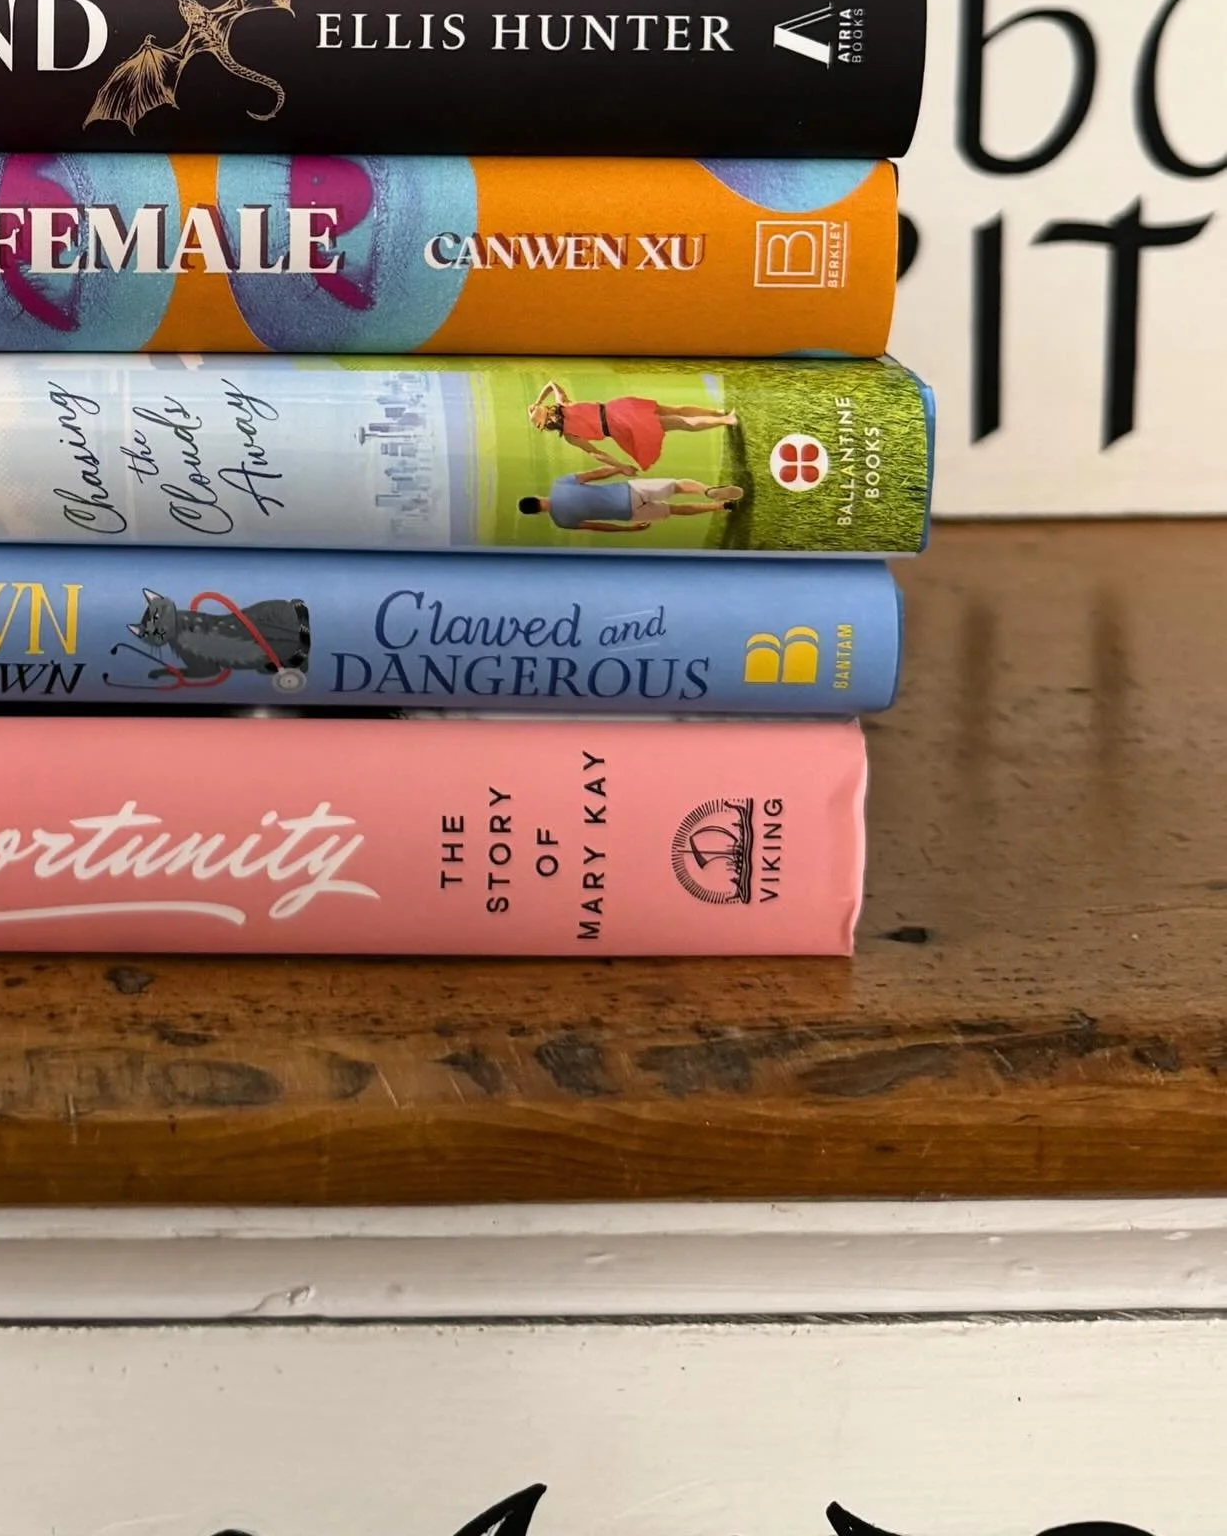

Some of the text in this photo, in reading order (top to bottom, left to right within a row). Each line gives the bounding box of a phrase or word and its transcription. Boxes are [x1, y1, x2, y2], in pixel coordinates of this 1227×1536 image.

[315, 13, 735, 54] ELLIS HUNTER
[837, 8, 852, 63] ATRIA
[852, 8, 864, 63] BOOKS
[423, 231, 707, 271] CANWEN XU
[827, 221, 841, 289] BERKLEY
[47, 381, 127, 534] Chasing
[119, 429, 159, 484] the
[132, 395, 234, 535] Clouds
[217, 378, 285, 517] Away
[834, 396, 855, 526] BALLANTINE
[864, 426, 880, 499] BOOKS
[374, 589, 667, 651] Clawed and
[331, 653, 710, 702] DANGEROUS
[832, 624, 853, 689] BANTAM
[440, 813, 466, 890] THE
[487, 786, 513, 913] STORY
[536, 827, 560, 877] OF
[577, 750, 607, 941] MARY KAY
[760, 797, 784, 904] VIKING
